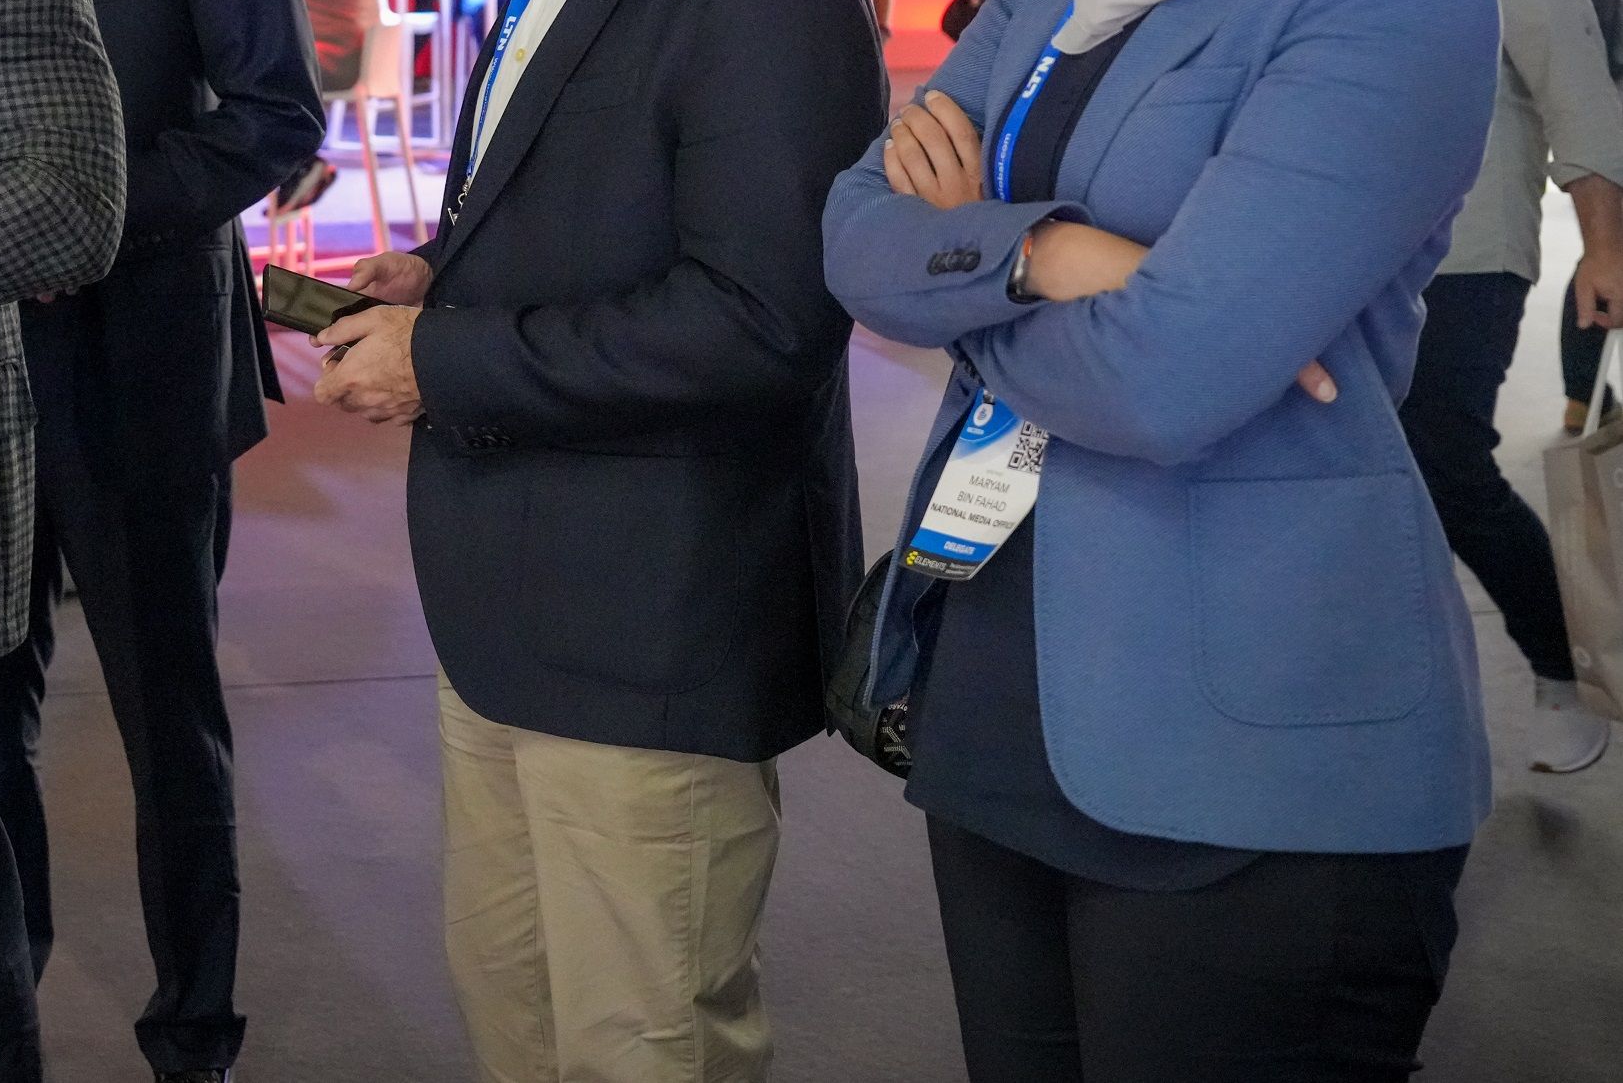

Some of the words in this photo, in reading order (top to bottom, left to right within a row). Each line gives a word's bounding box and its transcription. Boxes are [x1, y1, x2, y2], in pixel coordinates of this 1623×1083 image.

[497, 15, 518, 51] LTN
[1022, 55, 1056, 99] LTN
[968, 474, 1011, 494] MARYAM
[957, 490, 974, 504] BIN
[974, 495, 1007, 512] FAHAD
[931, 502, 967, 520] NATIONAL
[968, 512, 992, 527] MEDIA
